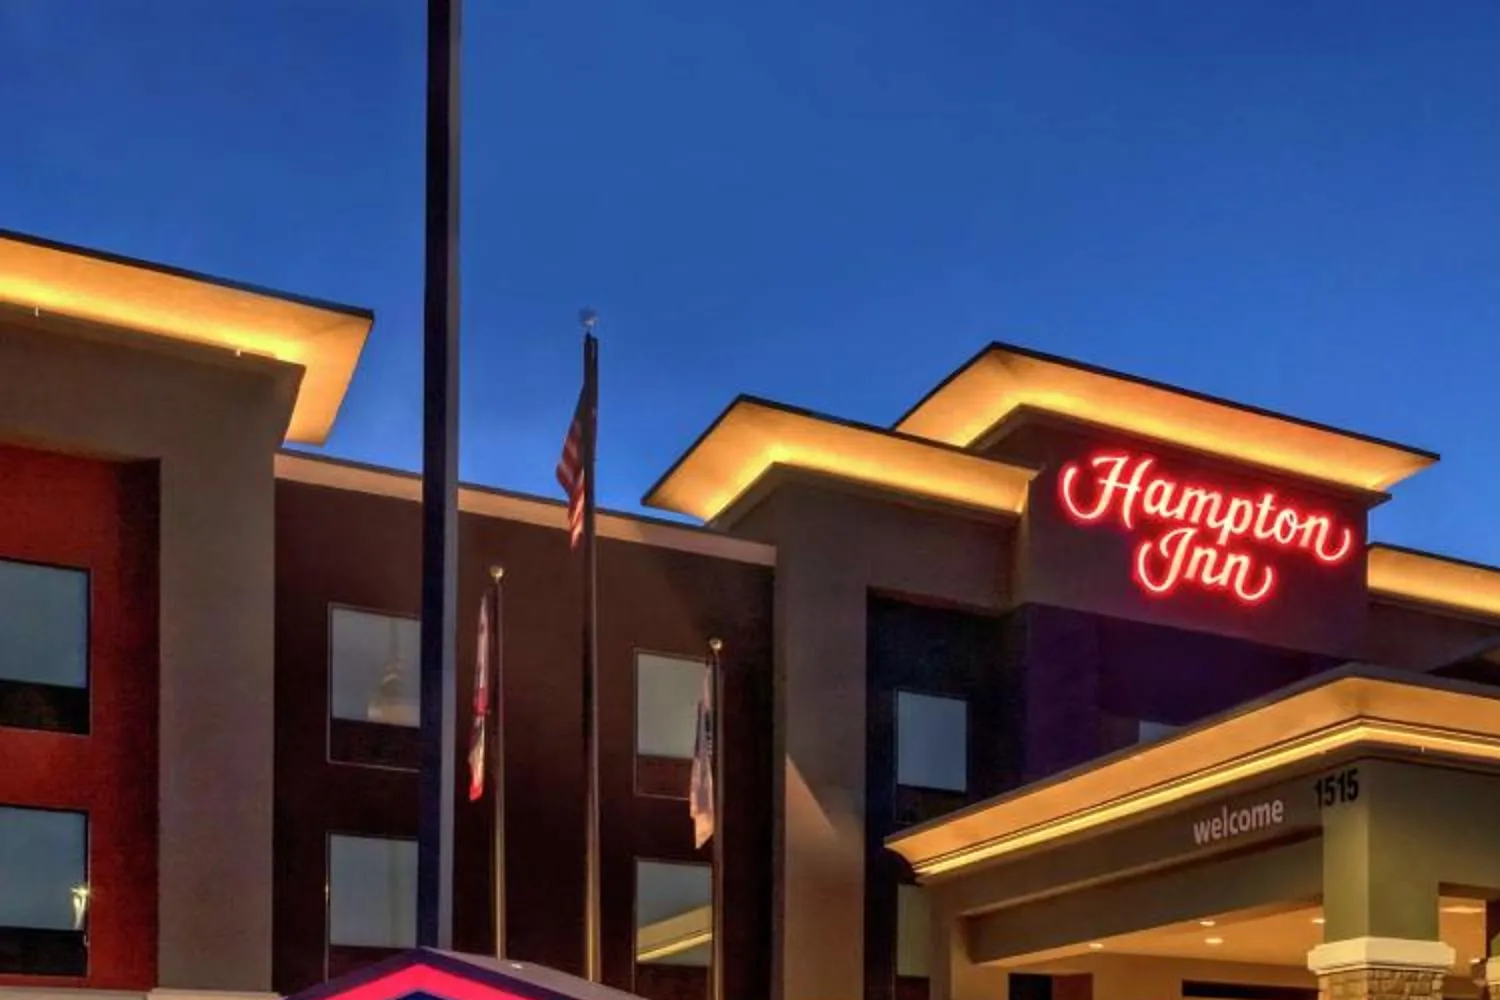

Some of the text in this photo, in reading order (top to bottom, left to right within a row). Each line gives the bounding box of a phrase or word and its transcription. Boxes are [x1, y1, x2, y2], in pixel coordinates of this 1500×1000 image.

[1062, 454, 1352, 562] Hampton
[1136, 526, 1274, 602] Inn
[1314, 768, 1359, 808] 1515
[1193, 799, 1285, 845] welcome
